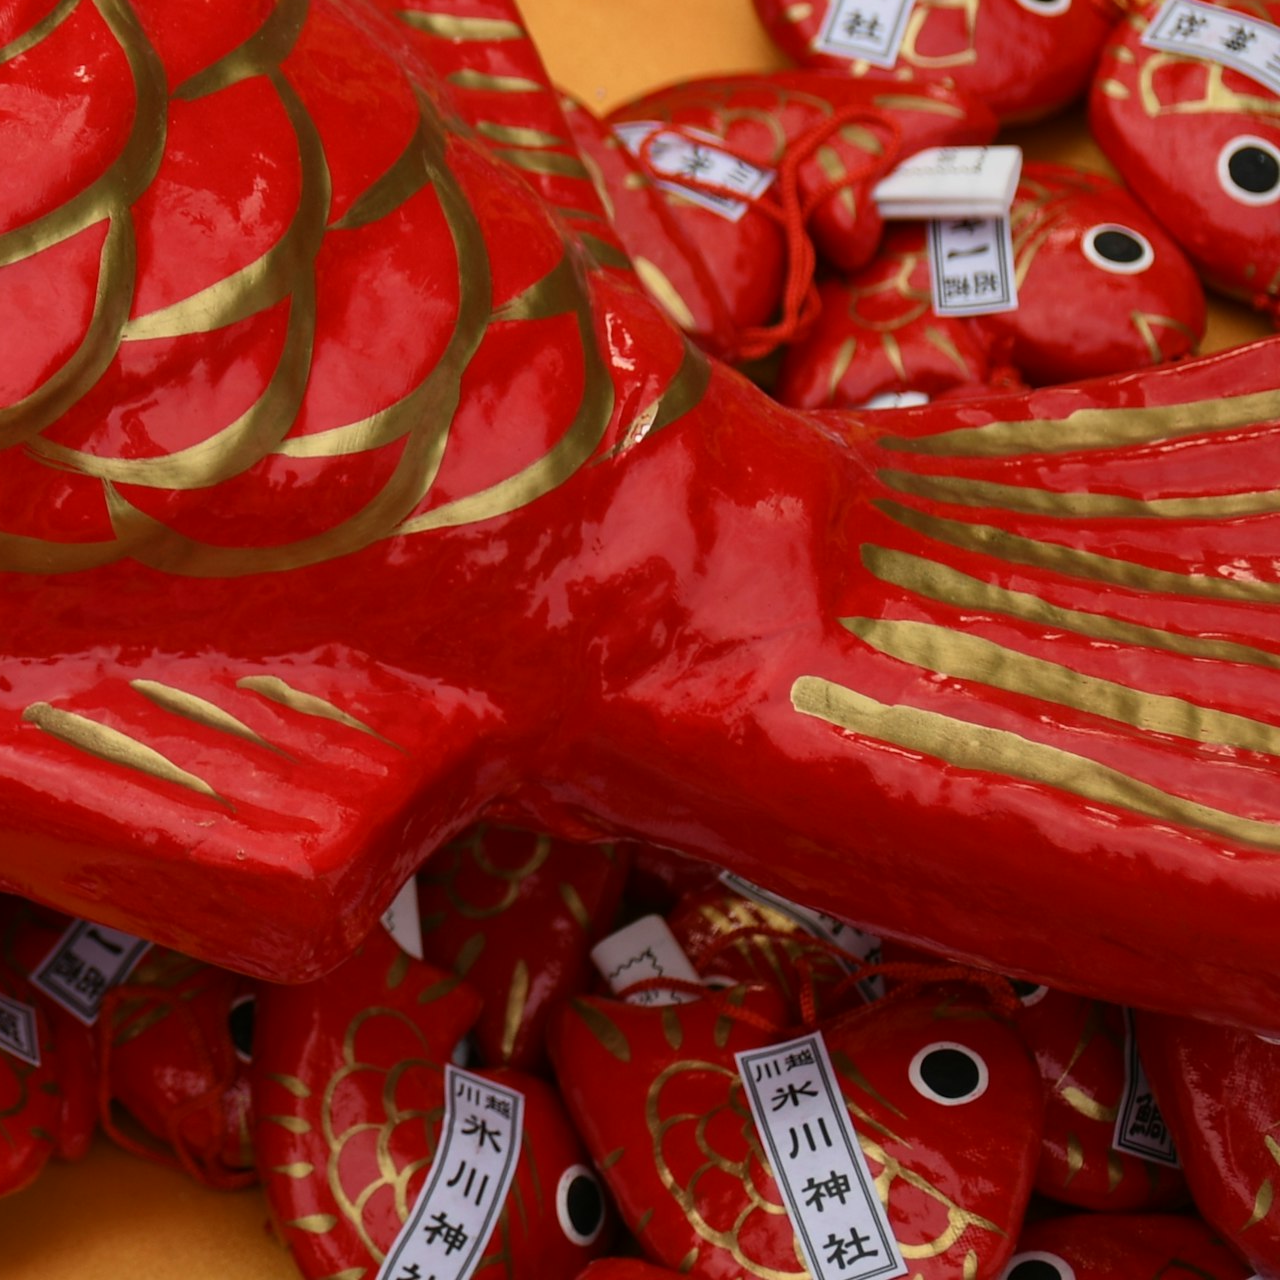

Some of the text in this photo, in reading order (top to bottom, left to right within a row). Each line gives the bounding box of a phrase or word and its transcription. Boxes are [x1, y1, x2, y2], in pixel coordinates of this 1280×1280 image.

[754, 1048, 881, 1272] 川越氷川神社
